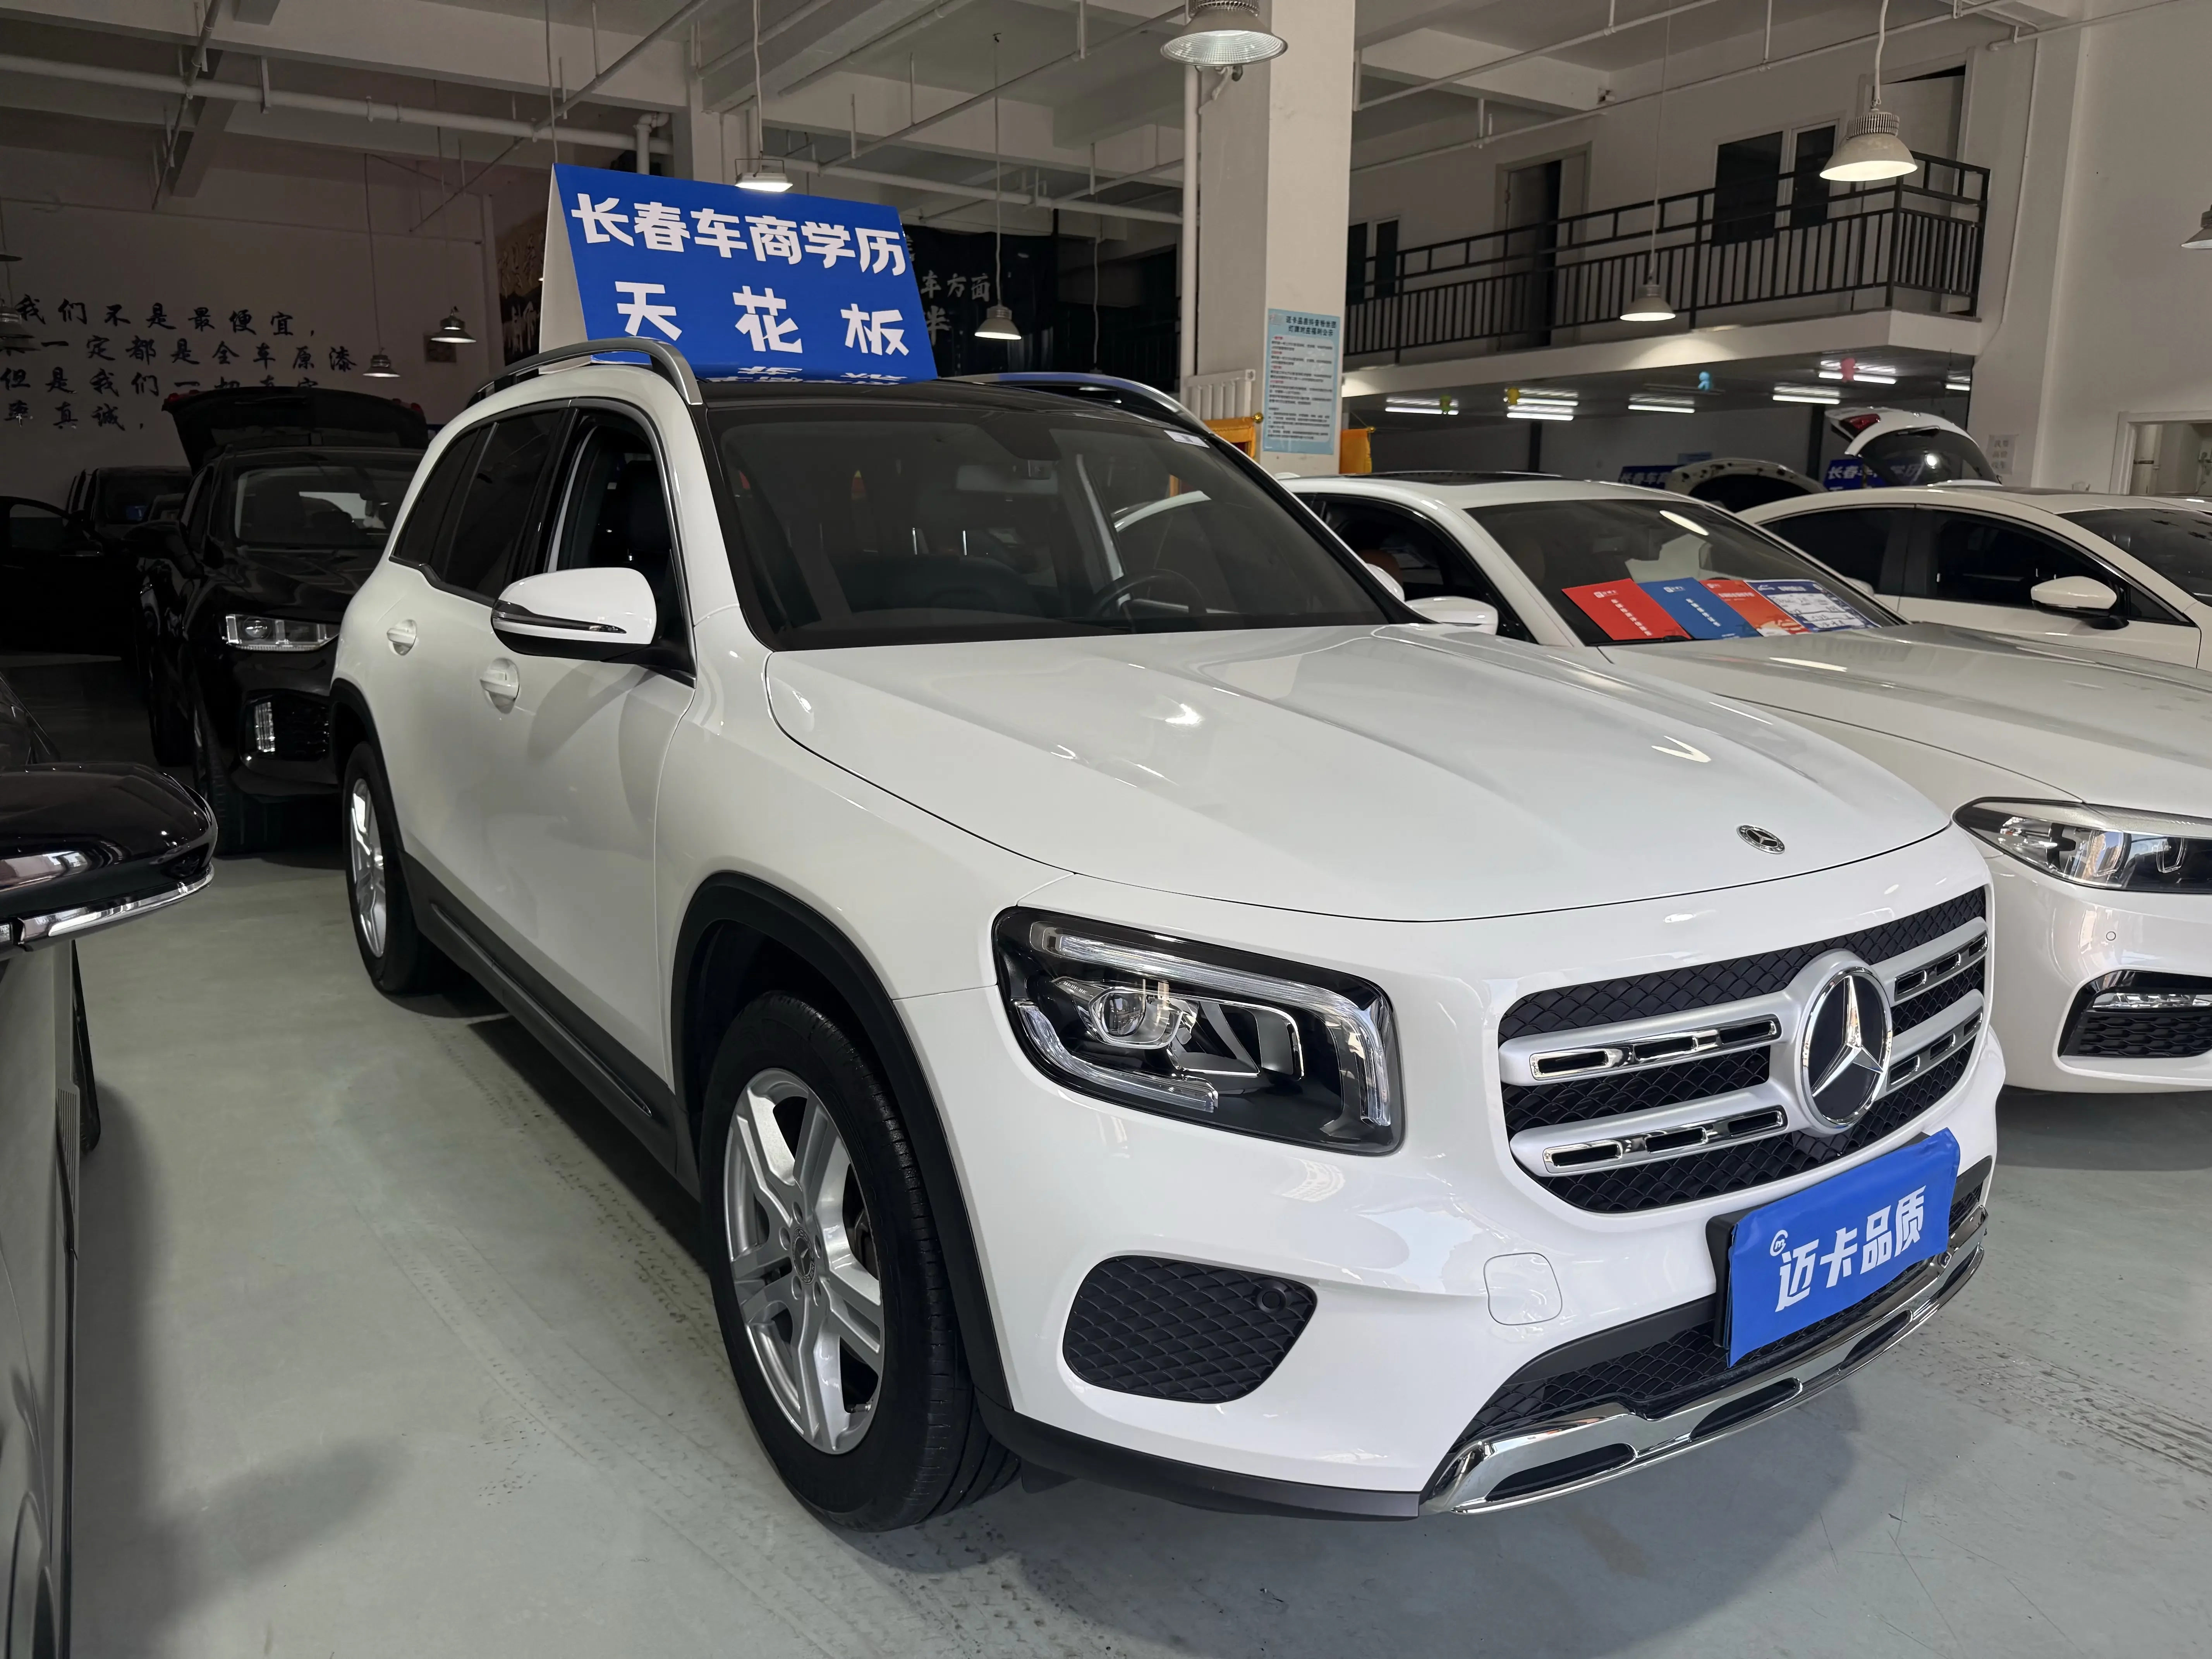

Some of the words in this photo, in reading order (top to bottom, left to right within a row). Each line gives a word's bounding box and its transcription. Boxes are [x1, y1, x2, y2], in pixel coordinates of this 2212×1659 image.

[571, 193, 906, 276] 长春车商学历
[0, 335, 357, 372] 一定都是全车原漆
[615, 281, 909, 356] 天花板
[1775, 1185, 1926, 1312] 迈卡品质
